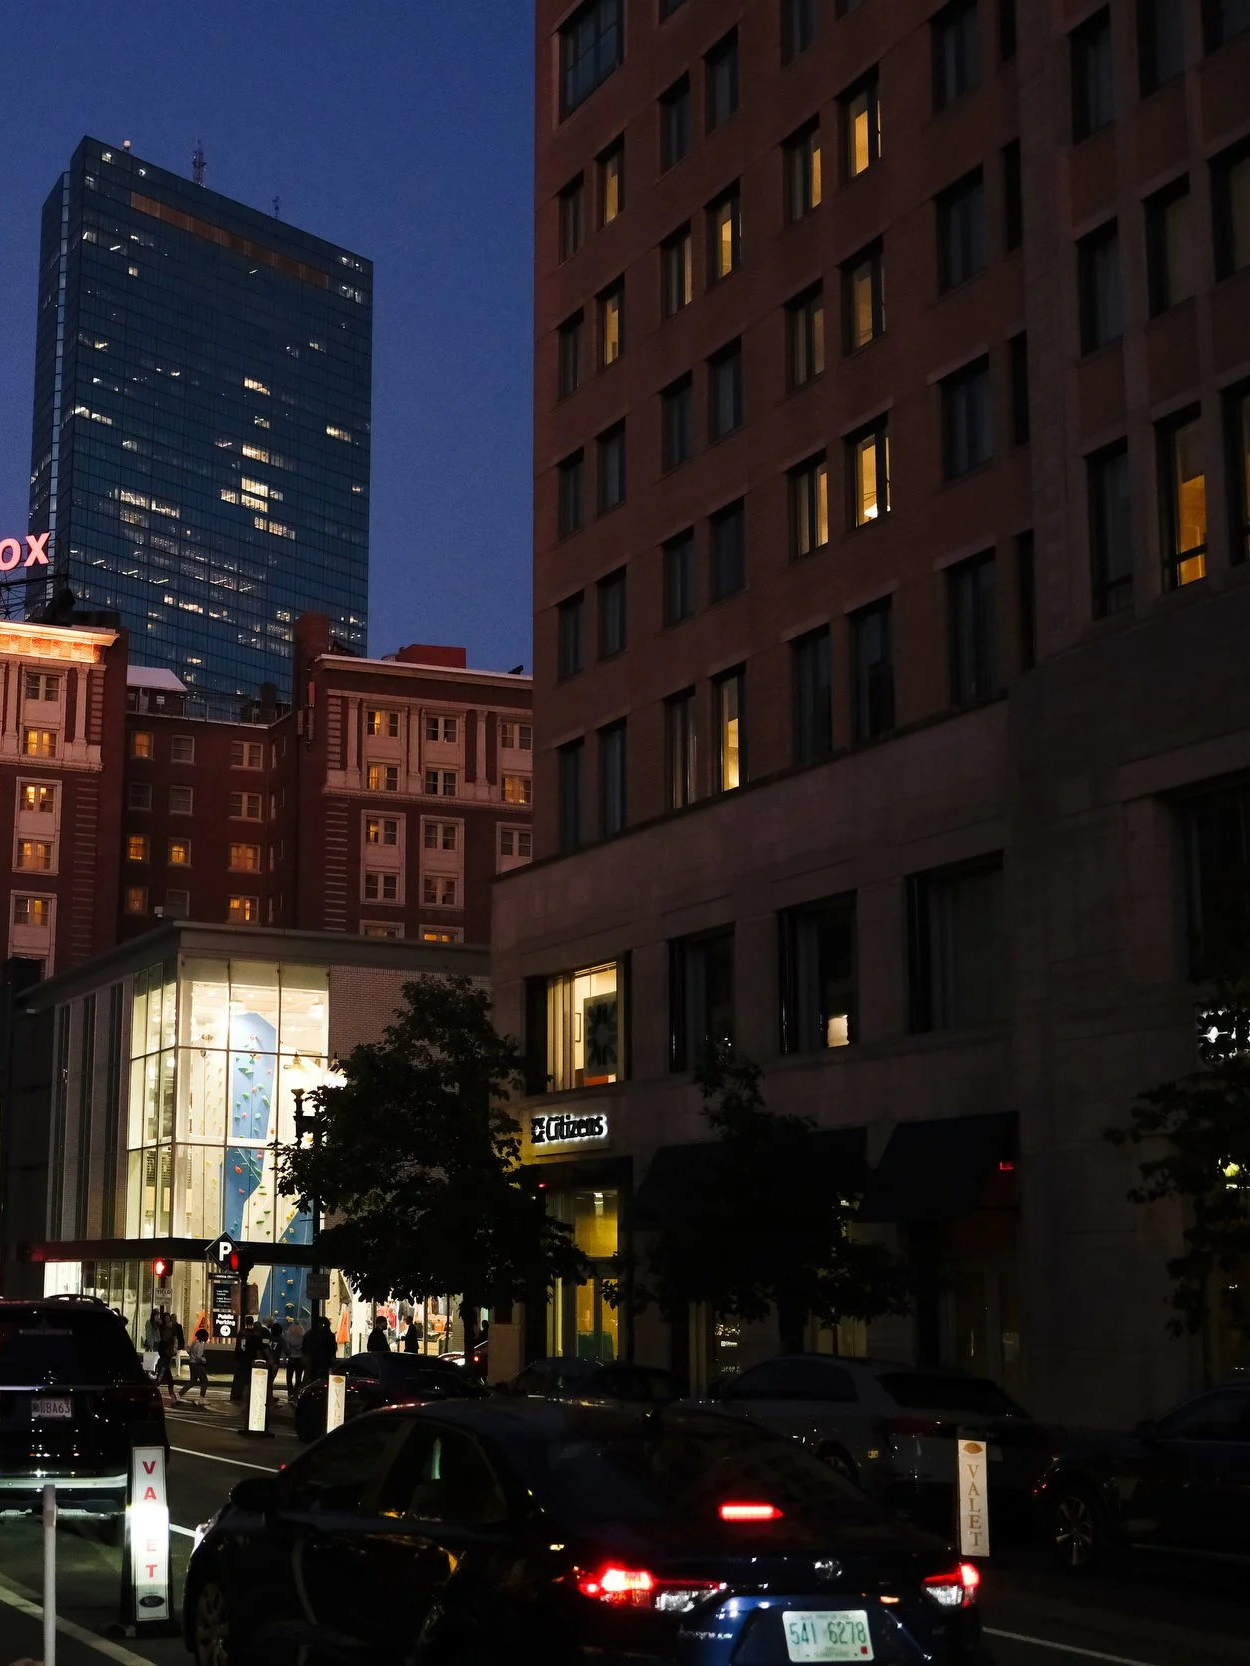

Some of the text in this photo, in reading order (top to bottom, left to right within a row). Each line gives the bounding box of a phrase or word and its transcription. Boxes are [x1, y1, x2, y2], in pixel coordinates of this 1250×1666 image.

[546, 1114, 604, 1141] Citizens
[218, 1241, 233, 1262] P
[967, 1463, 982, 1547] VALET
[142, 1460, 158, 1578] VAET
[827, 1620, 868, 1645] 6278
